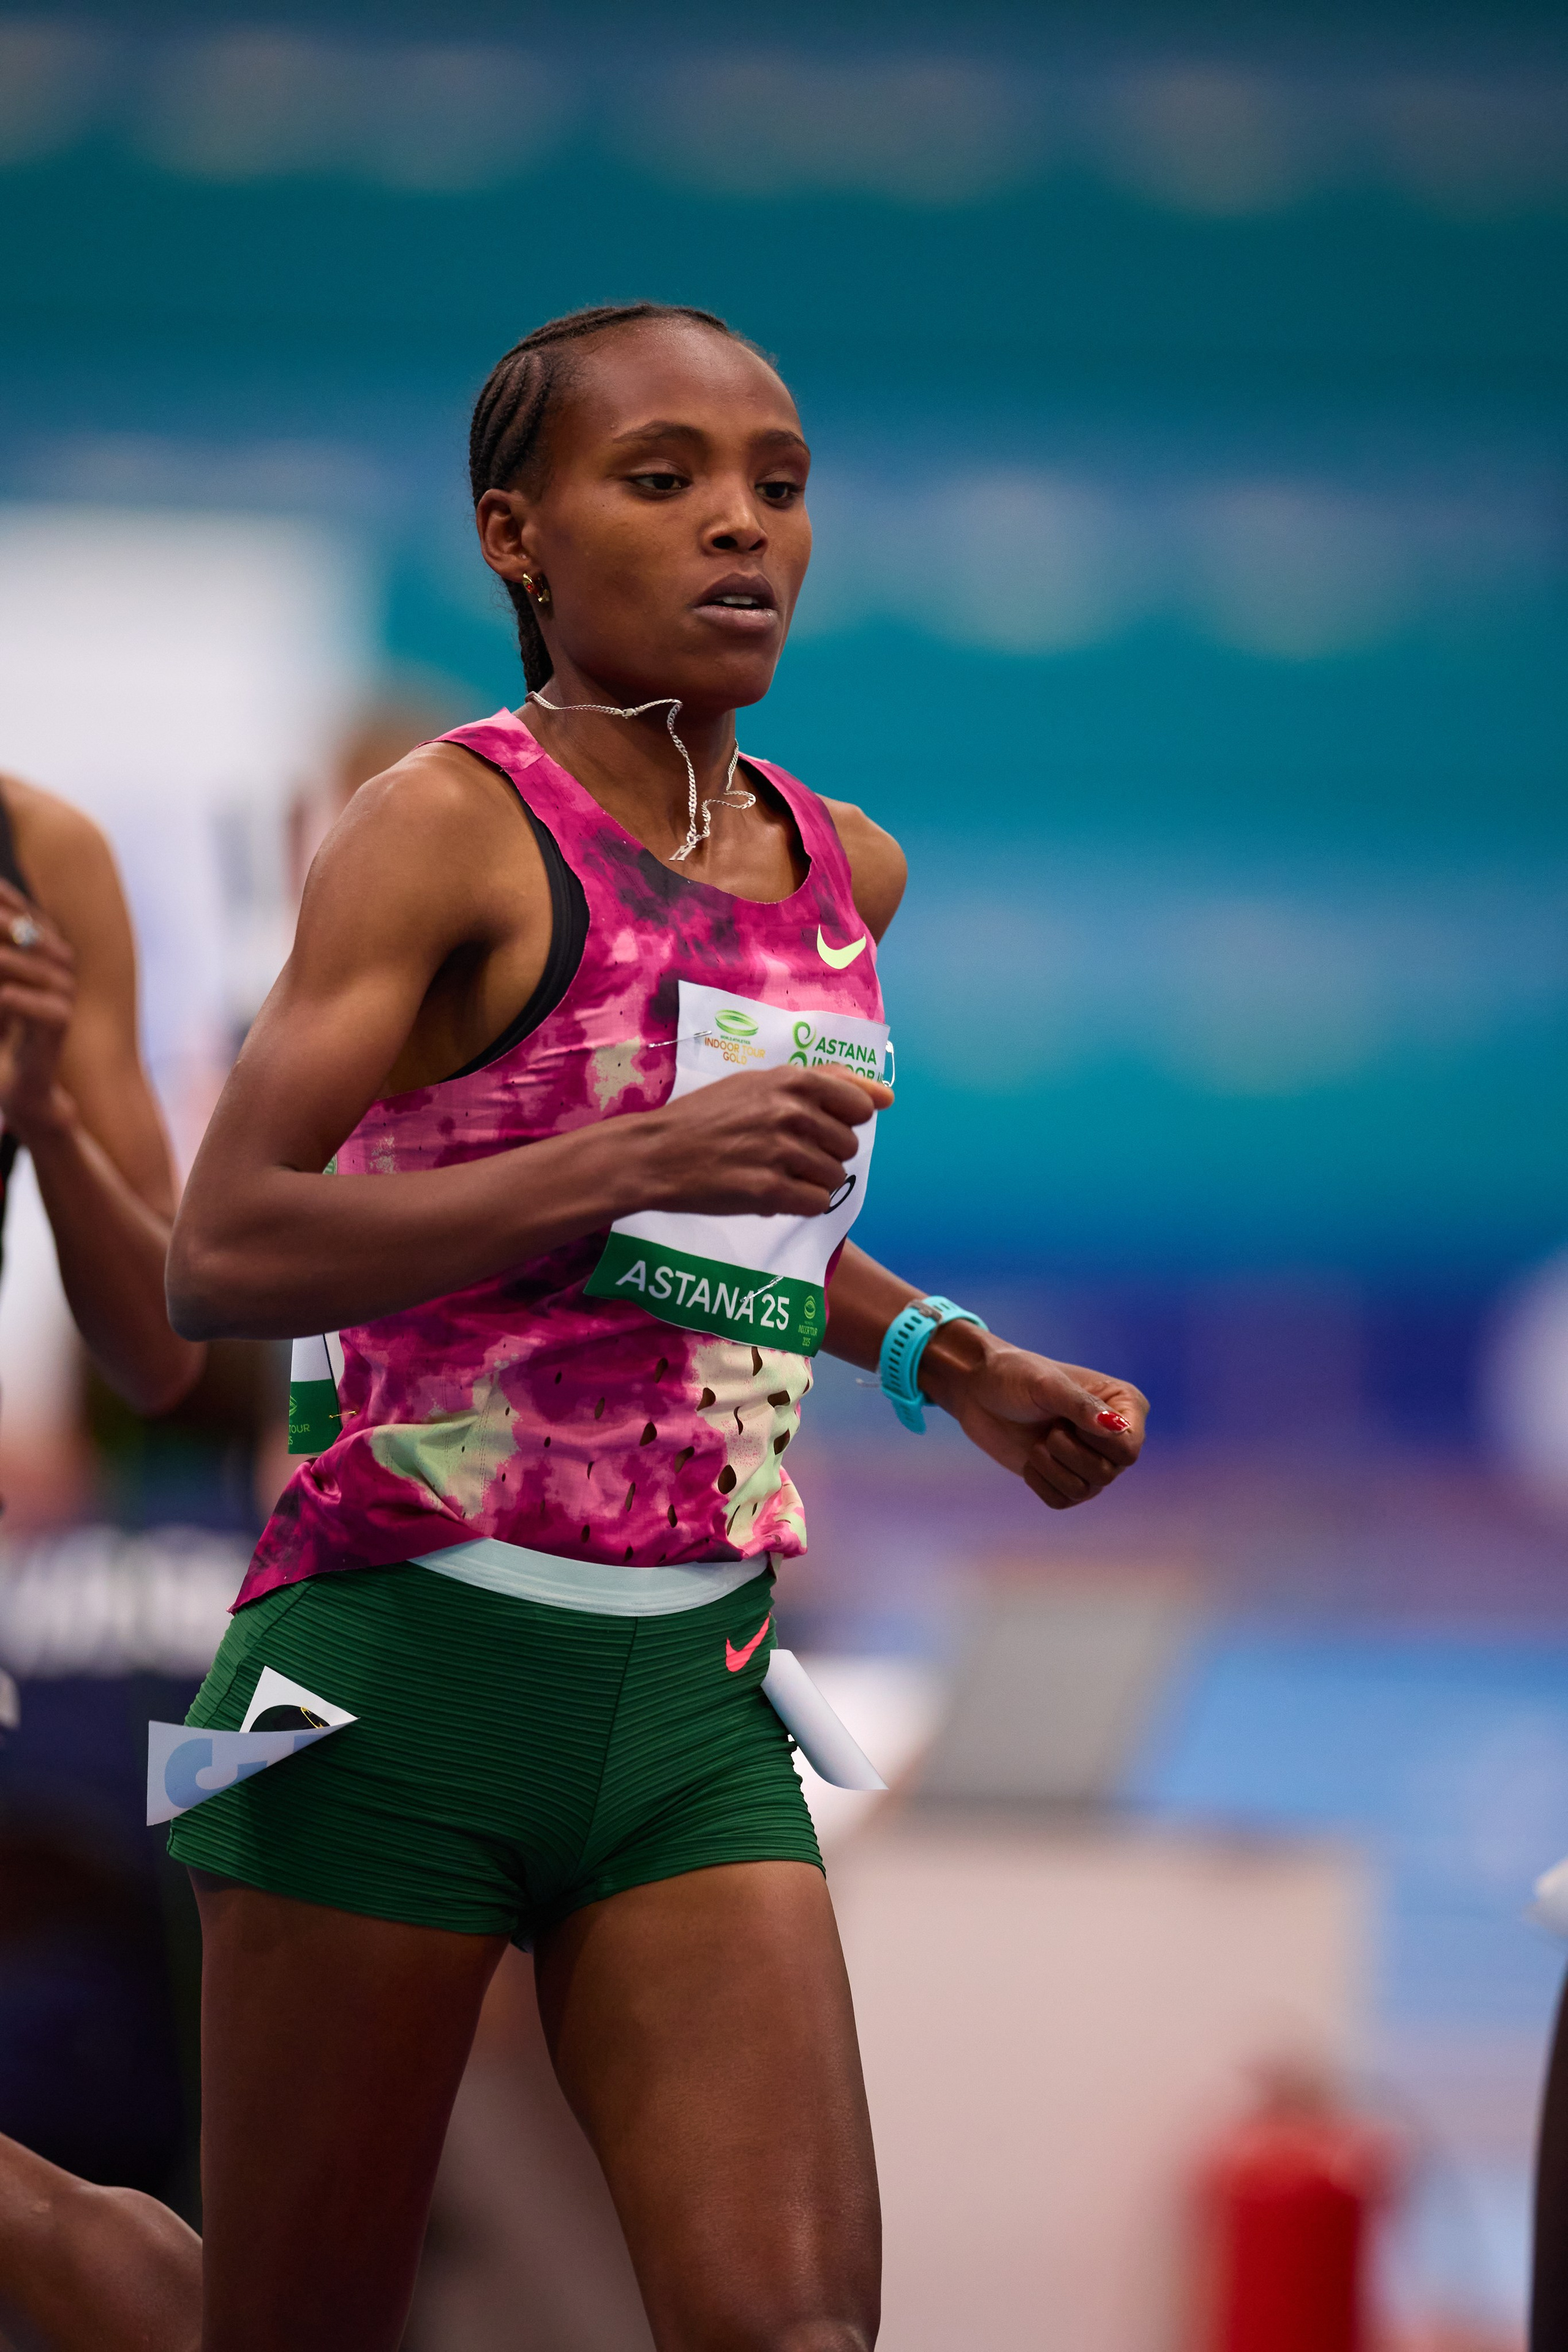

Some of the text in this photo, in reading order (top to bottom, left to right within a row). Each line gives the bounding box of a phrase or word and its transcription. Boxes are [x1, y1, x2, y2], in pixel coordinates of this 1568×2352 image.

[704, 1036, 766, 1058] INDOOR TOUR
[723, 1051, 747, 1065] GOLD
[814, 1036, 877, 1066] ASTANA
[812, 1057, 875, 1080] IOR
[616, 1260, 790, 1331] ASTANA 25
